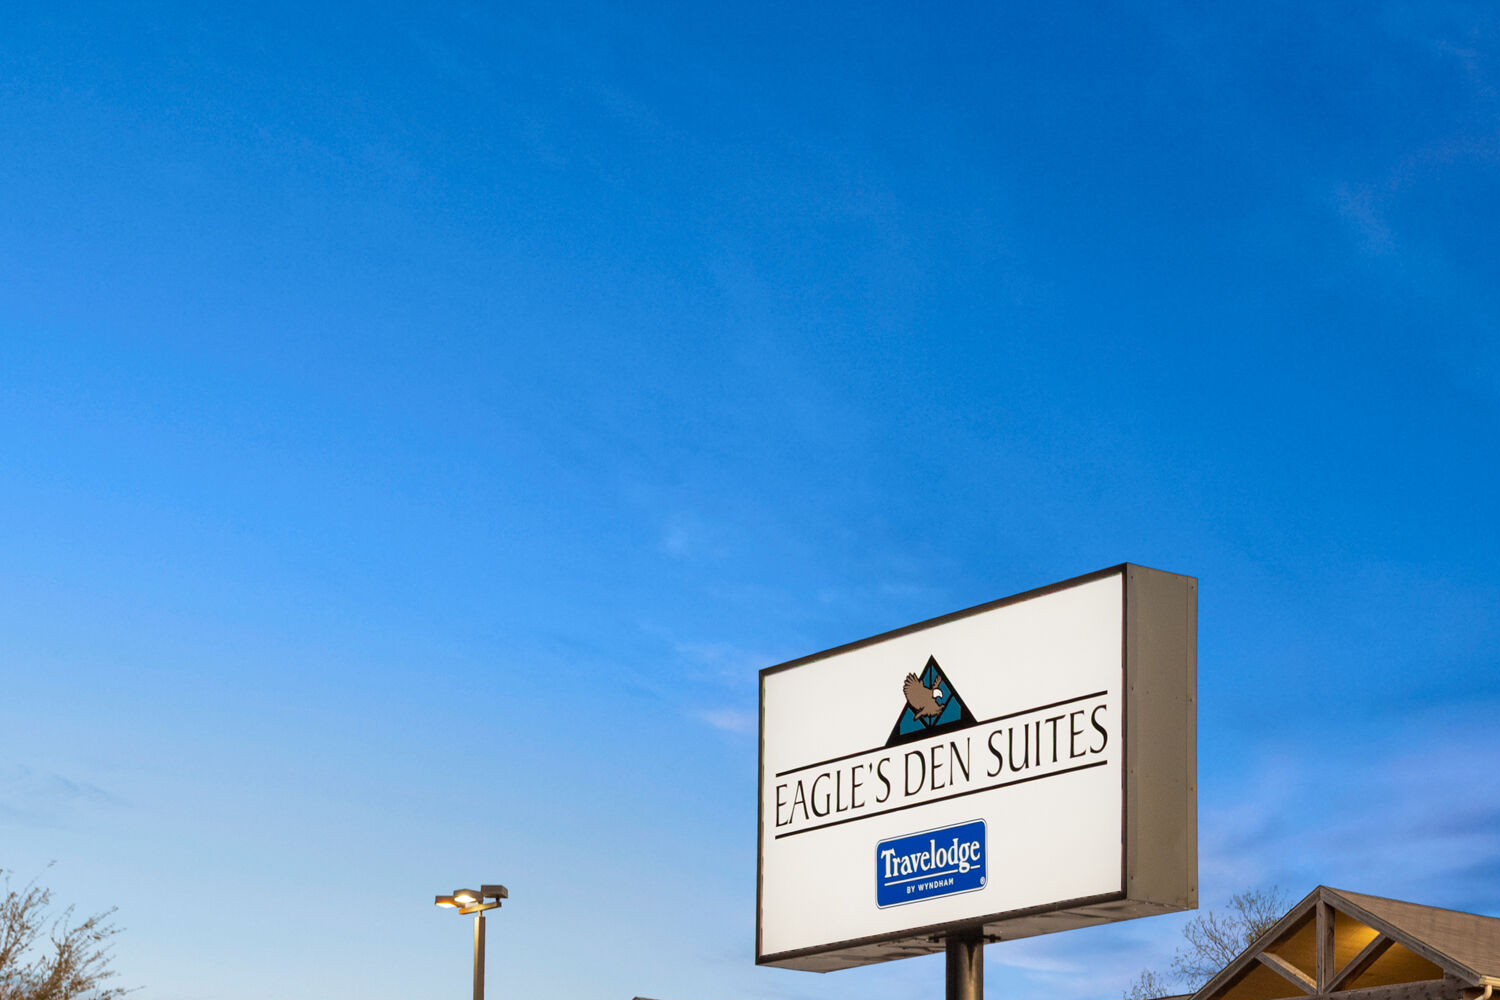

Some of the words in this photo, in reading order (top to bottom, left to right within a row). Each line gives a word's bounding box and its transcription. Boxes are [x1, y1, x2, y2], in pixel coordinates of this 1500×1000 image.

[775, 757, 892, 828] EAGLE'S
[904, 736, 971, 797] DEN
[986, 703, 1109, 778] SUITES
[880, 837, 981, 879] Travelodge
[906, 885, 916, 894] BY
[918, 877, 954, 892] WYNDHAM
